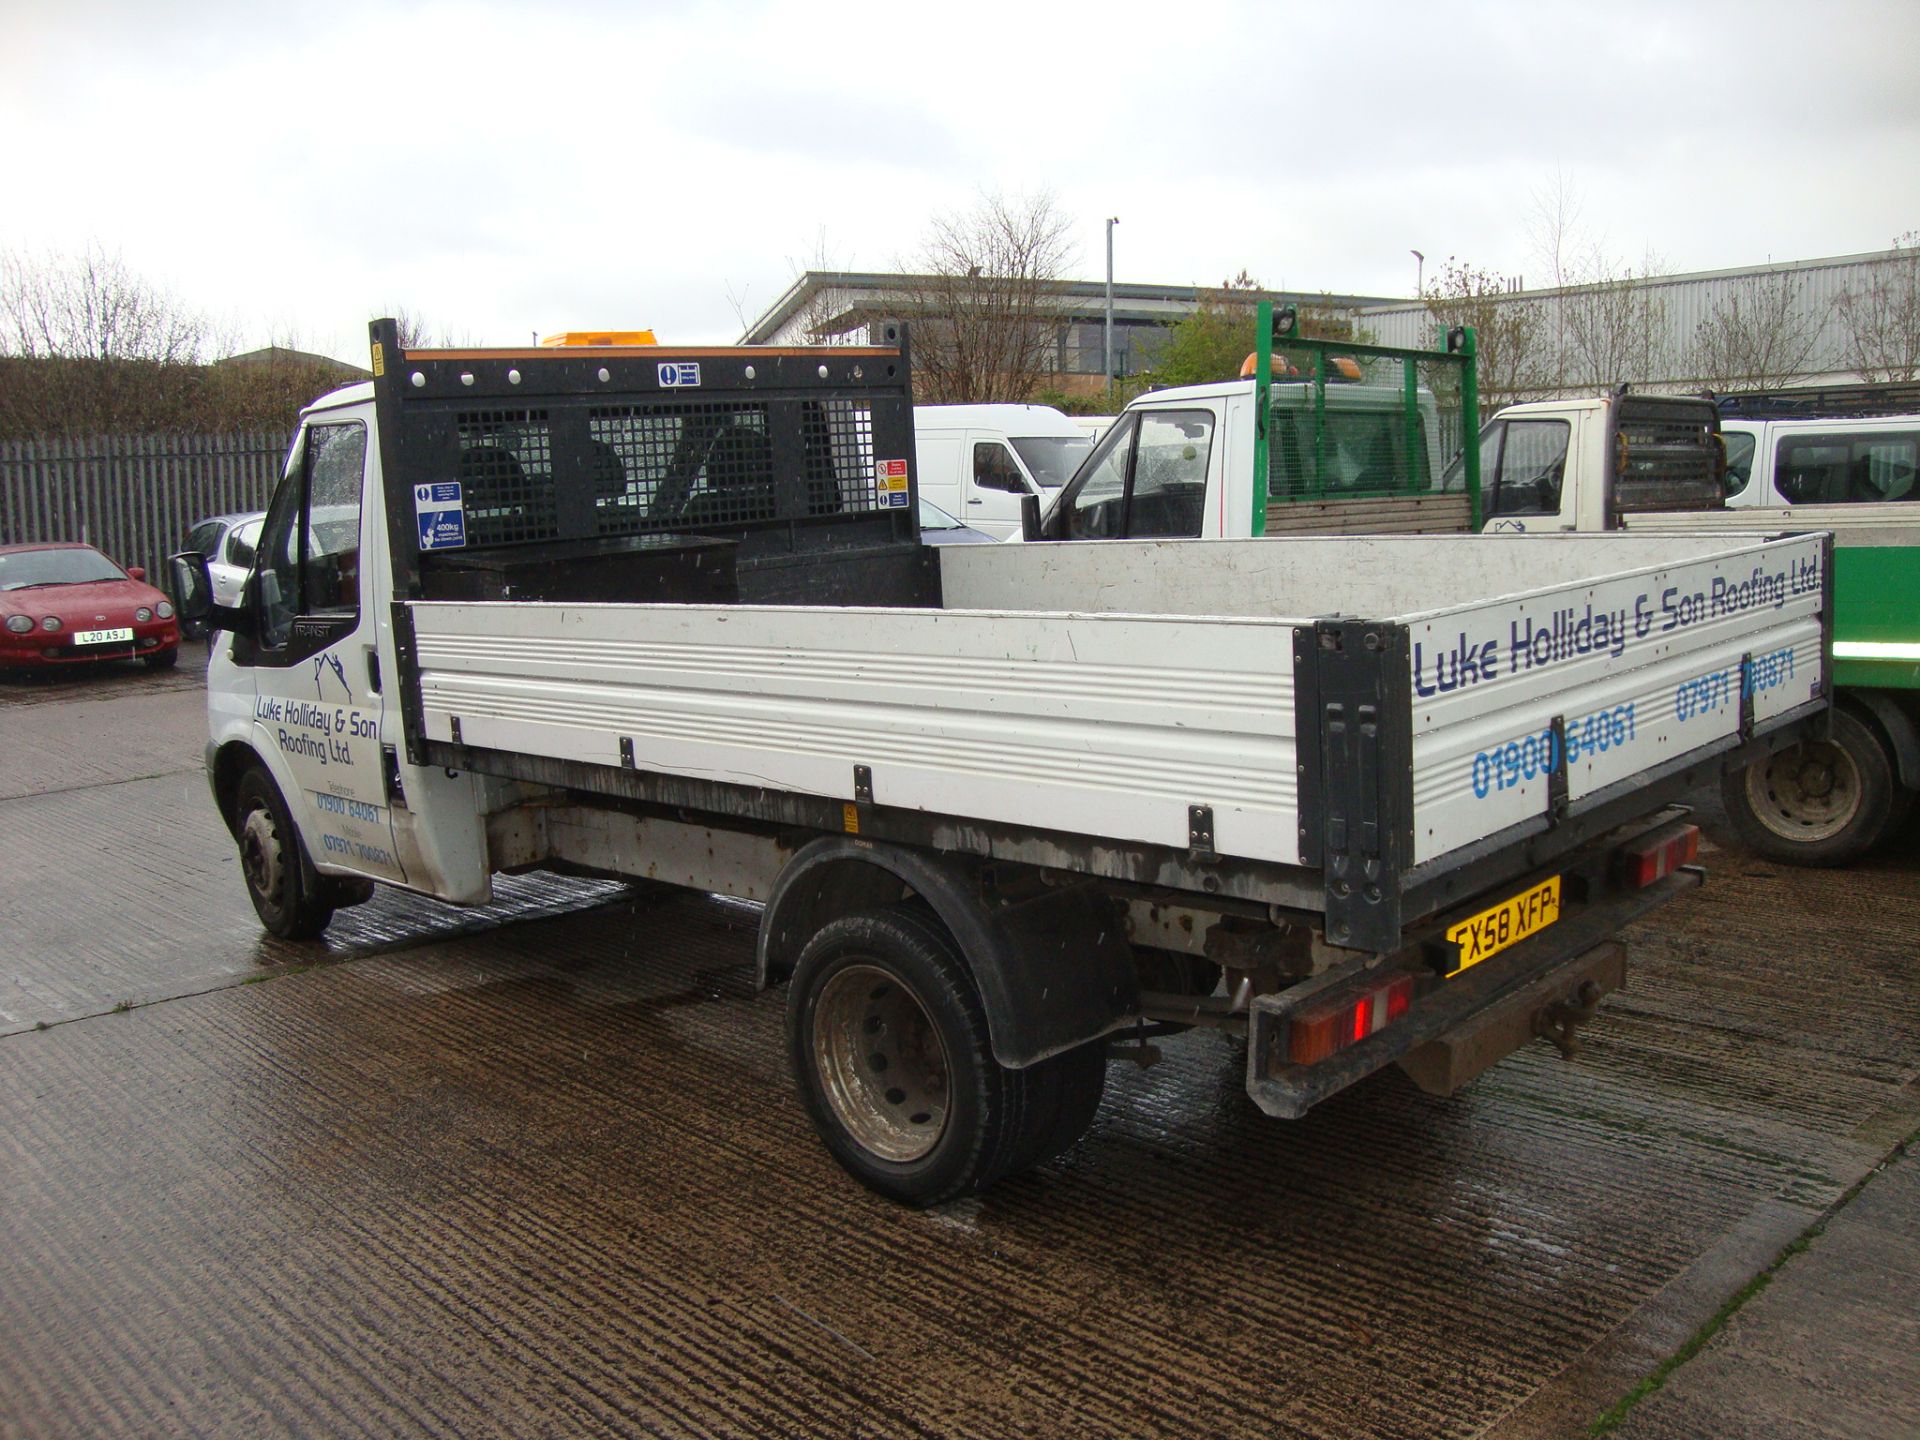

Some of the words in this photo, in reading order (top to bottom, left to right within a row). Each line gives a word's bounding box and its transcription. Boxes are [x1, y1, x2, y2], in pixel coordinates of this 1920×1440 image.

[82, 632, 103, 643] L20
[106, 629, 126, 640] ASJ
[1414, 632, 1498, 698] Luke
[1511, 603, 1626, 673] Holliday
[1635, 593, 1654, 639] &
[1662, 586, 1706, 632] Son
[1711, 566, 1786, 618] Roofing
[1791, 554, 1822, 595] Ltd.
[256, 695, 282, 721] Luke
[284, 699, 331, 737] Holliday
[335, 708, 346, 733] &
[350, 711, 377, 740] Son
[1676, 669, 1729, 722] 07971
[278, 728, 327, 765] Roofing
[328, 738, 354, 766] Ltd.
[1472, 727, 1559, 799] 01900
[1566, 702, 1635, 764] 64061
[316, 792, 345, 815] 01900
[349, 800, 380, 825] 64061
[323, 833, 355, 857] 07971
[1456, 907, 1510, 961] FX58
[1515, 886, 1552, 936] XFP
